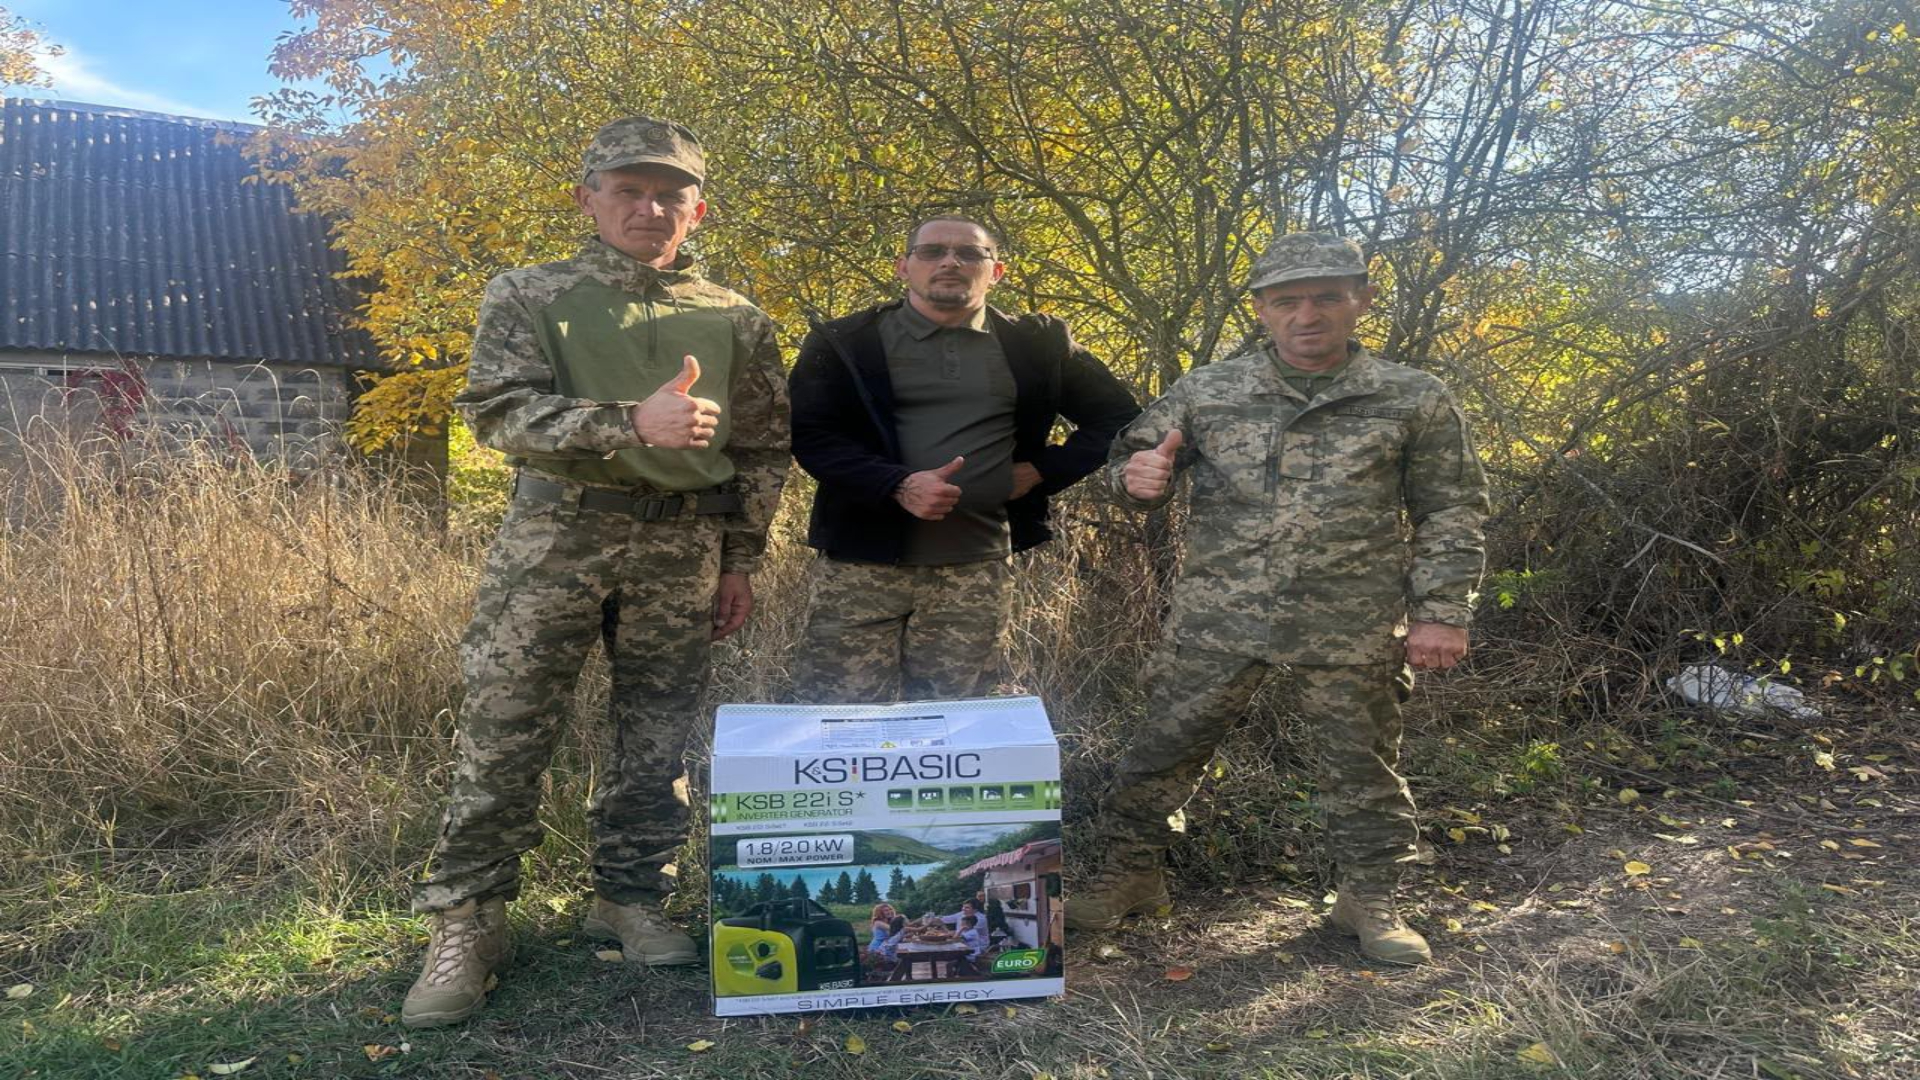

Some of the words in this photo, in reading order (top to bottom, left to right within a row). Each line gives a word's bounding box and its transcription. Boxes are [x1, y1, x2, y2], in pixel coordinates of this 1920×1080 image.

[862, 753, 981, 782] BASIC
[736, 793, 785, 811] KSB
[793, 791, 831, 809] 22i
[736, 810, 788, 821] INVERTER
[790, 808, 853, 819] GENERATOR
[746, 840, 810, 856] 1.8/2.0
[815, 838, 844, 853] kW
[805, 852, 844, 862] POWER
[996, 959, 1033, 969] EURO
[797, 994, 889, 1010] SIMPLE
[900, 988, 995, 1003] ENERGY
